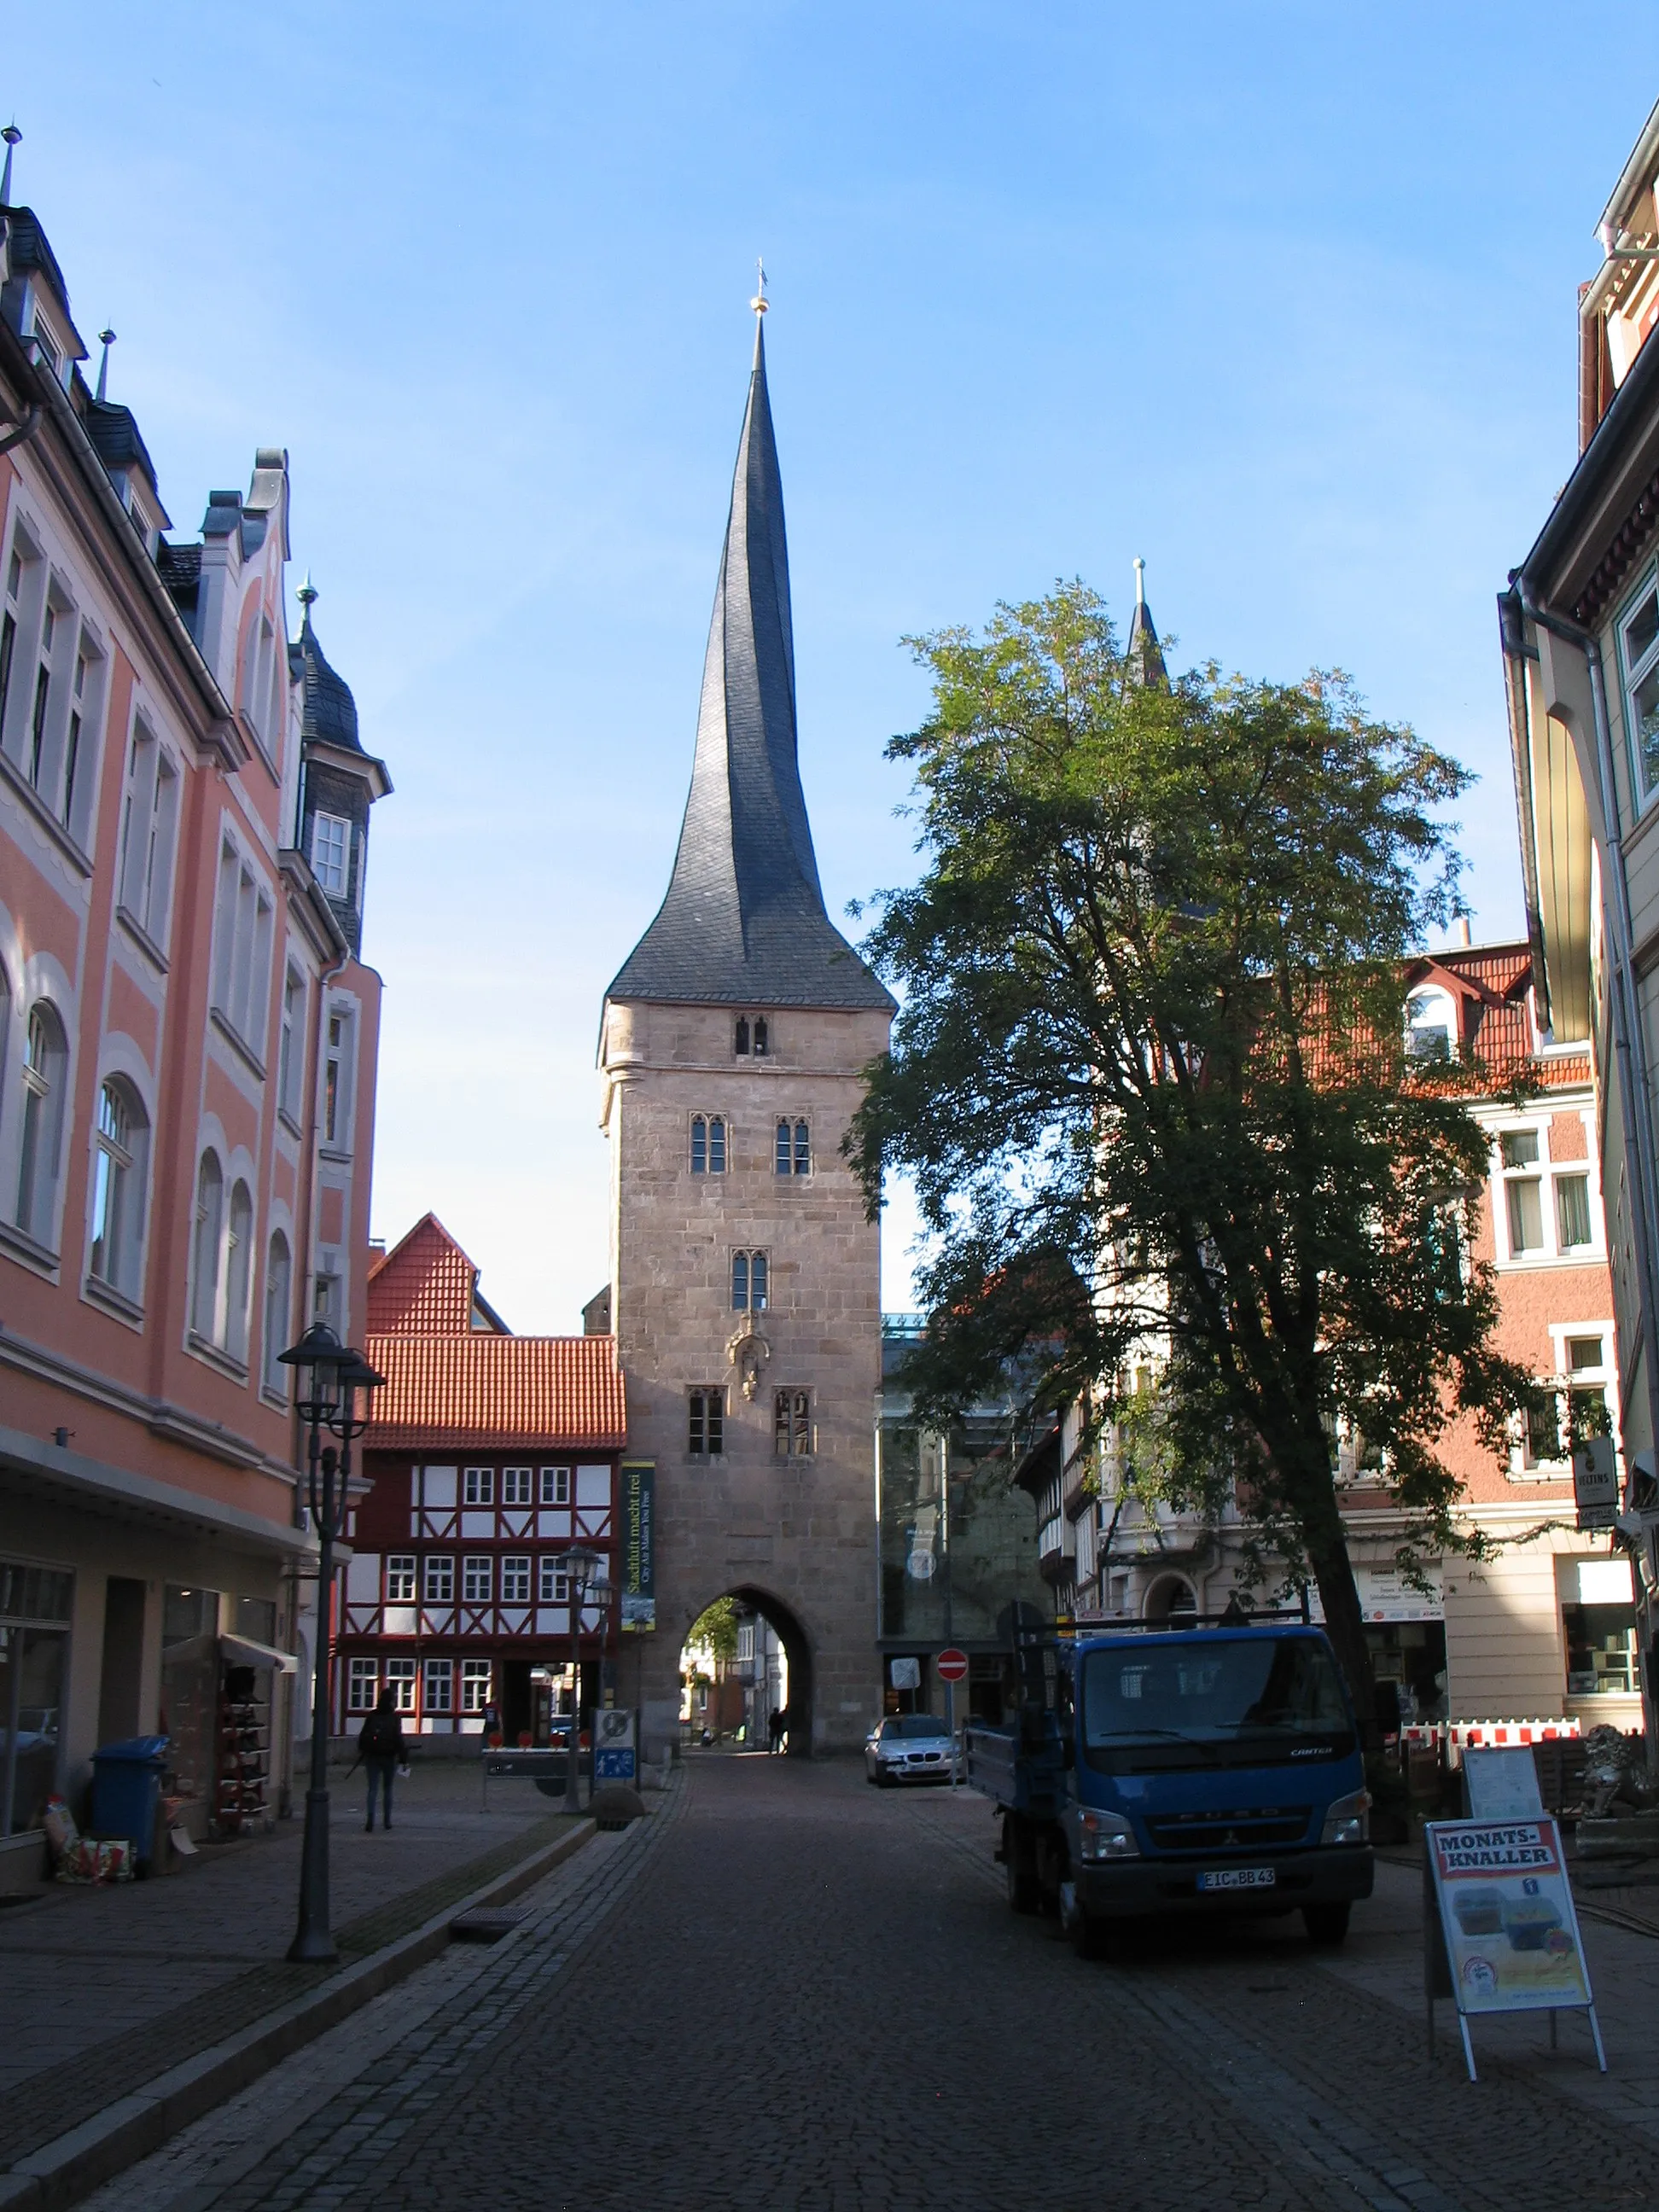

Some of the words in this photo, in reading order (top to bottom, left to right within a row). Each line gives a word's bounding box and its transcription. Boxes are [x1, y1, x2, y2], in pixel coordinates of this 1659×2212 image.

[627, 1474, 640, 1495] frei
[628, 1499, 640, 1537] macht
[641, 1510, 649, 1523] You
[641, 1524, 649, 1551] Makes
[627, 1540, 640, 1594] Stadtluft
[641, 1551, 649, 1565] Air
[641, 1565, 650, 1583] City
[1290, 1748, 1333, 1756] CANTER
[1179, 1807, 1278, 1819] FUSO
[1440, 1829, 1536, 1851] MONATS-
[1448, 1848, 1549, 1866] KNALLER
[1205, 1872, 1230, 1887] EIC
[1238, 1870, 1255, 1884] BB
[1259, 1869, 1274, 1883] 43
